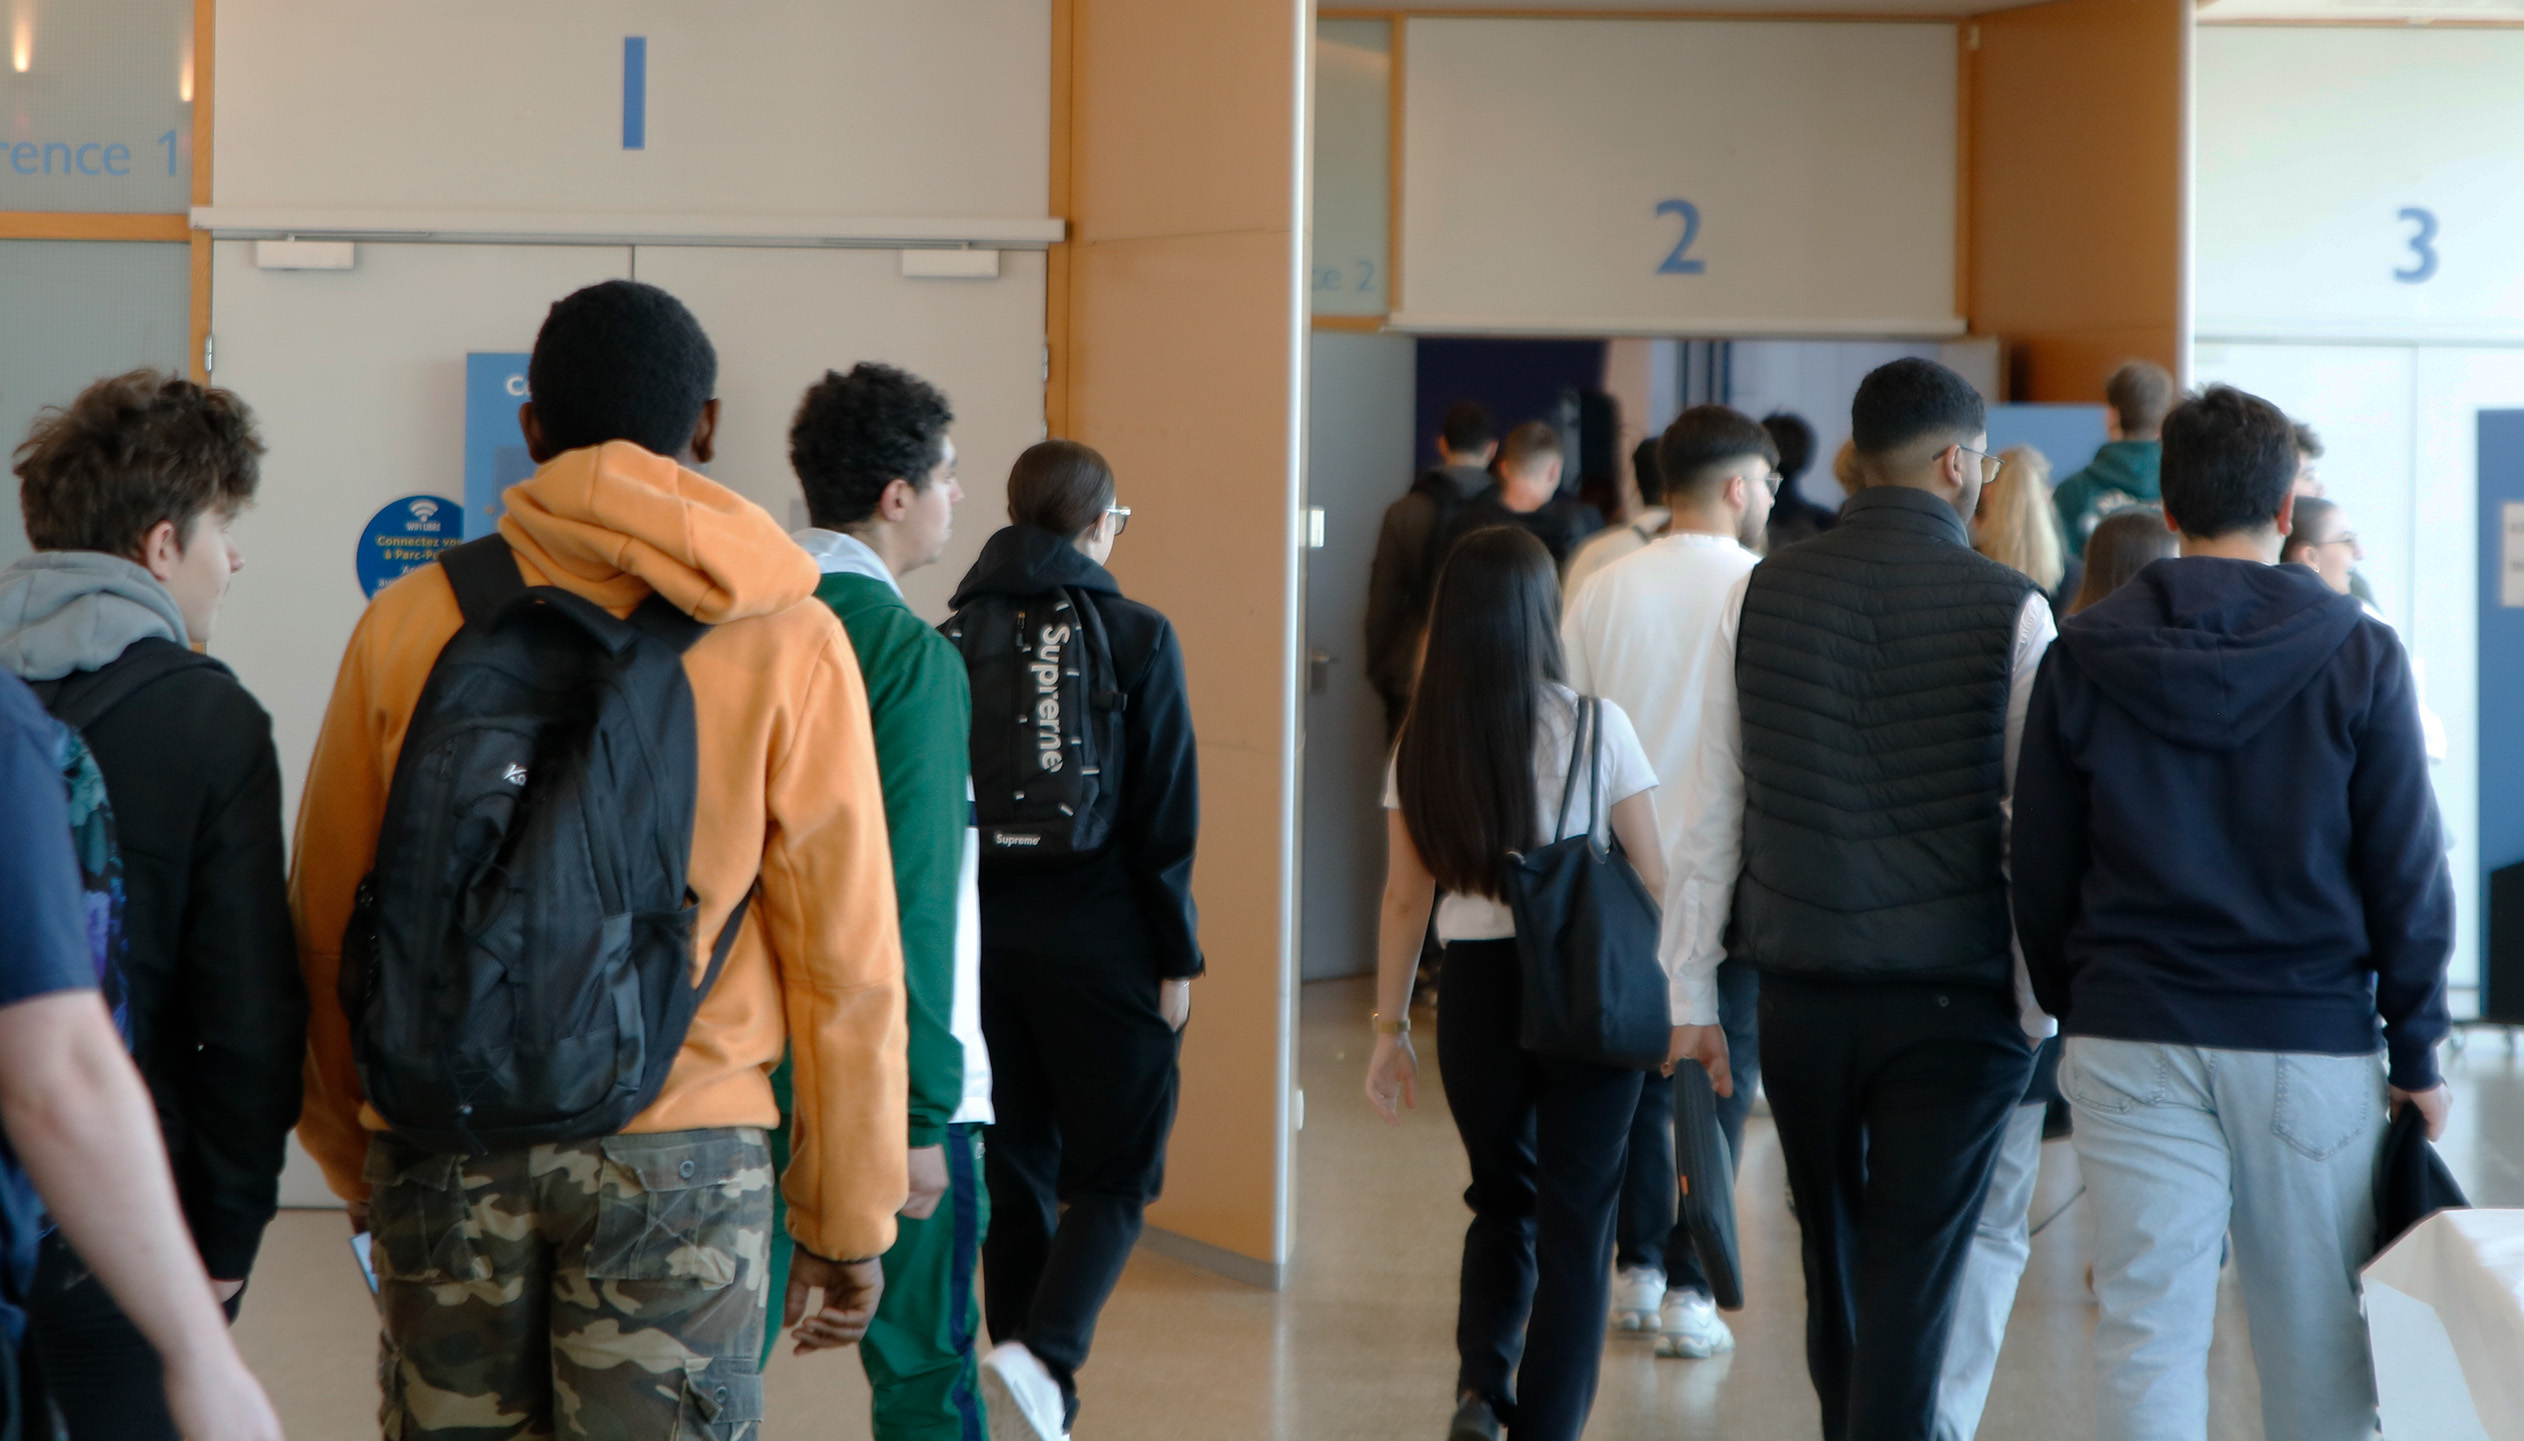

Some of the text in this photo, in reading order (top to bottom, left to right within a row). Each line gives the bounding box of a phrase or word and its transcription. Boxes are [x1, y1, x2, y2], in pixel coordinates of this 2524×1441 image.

[157, 129, 178, 177] 1
[1656, 199, 1704, 273] 2
[2393, 207, 2439, 283] 3
[1356, 259, 1377, 292] 2
[377, 535, 439, 547] Connectez
[996, 833, 1041, 848] Supreme
